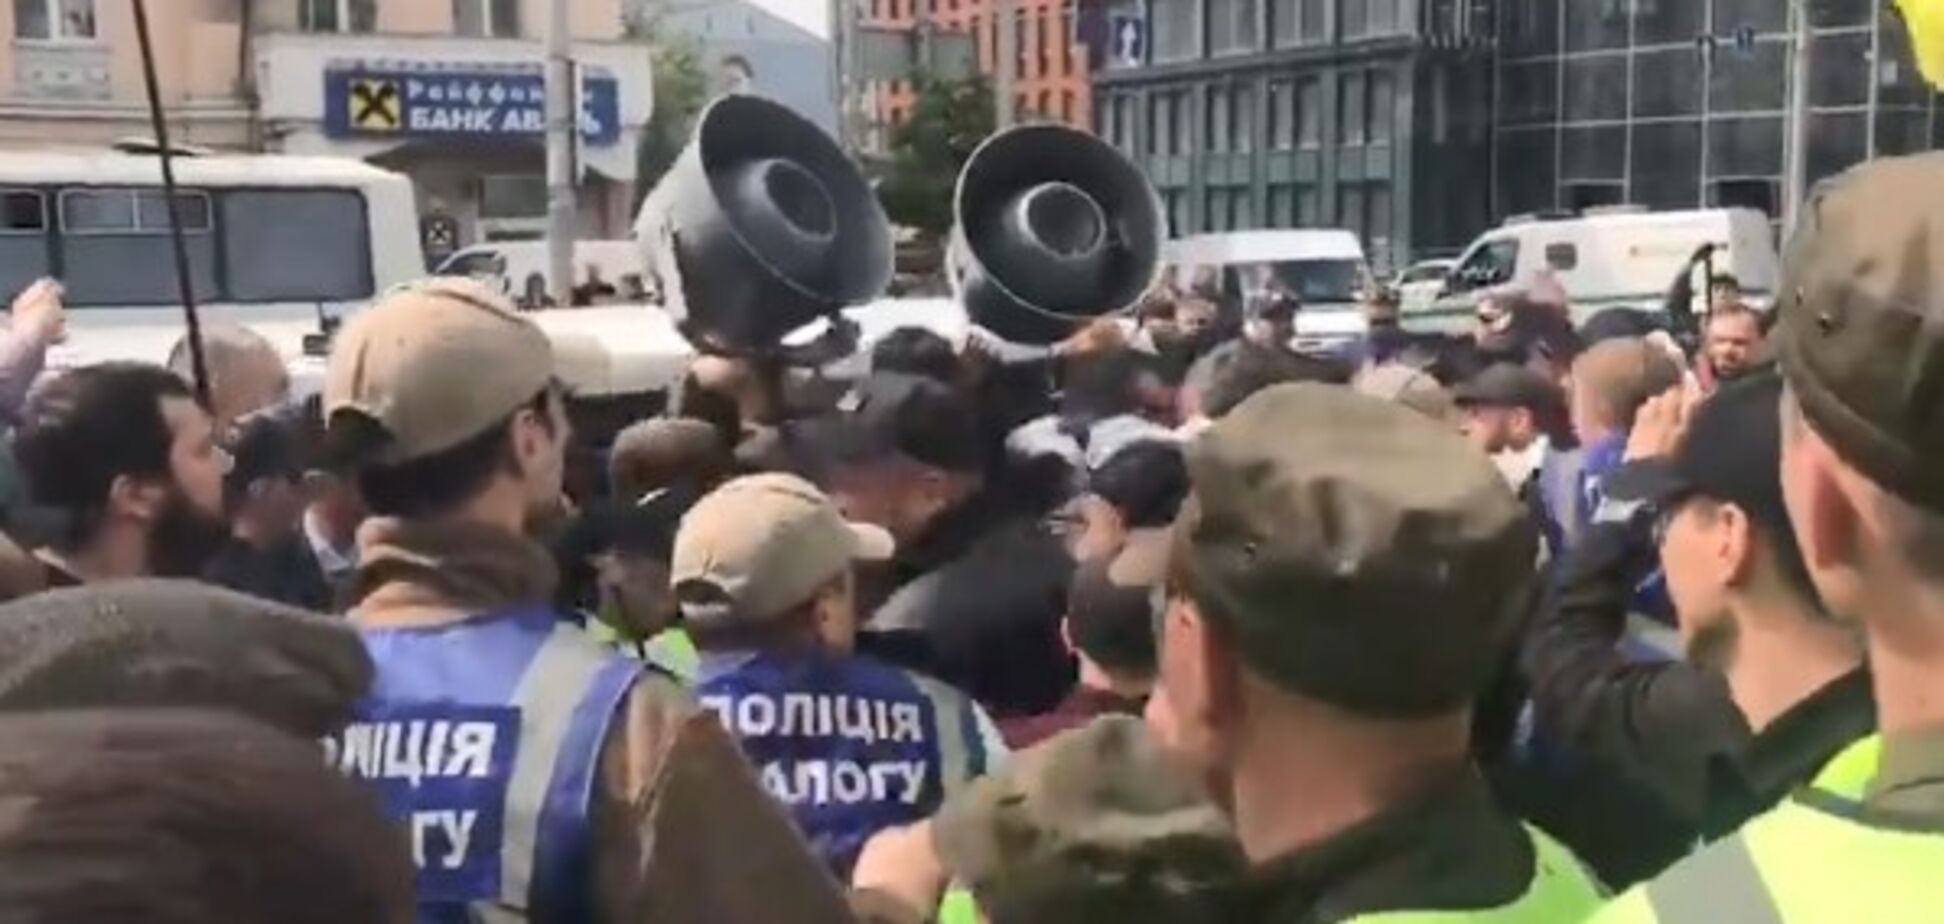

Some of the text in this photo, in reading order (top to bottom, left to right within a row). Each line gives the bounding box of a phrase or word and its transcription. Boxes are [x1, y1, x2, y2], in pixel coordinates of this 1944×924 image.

[409, 107, 496, 131] БАНК
[322, 719, 497, 788] ЛІЦІЯ
[761, 757, 927, 805] АЛОГУ
